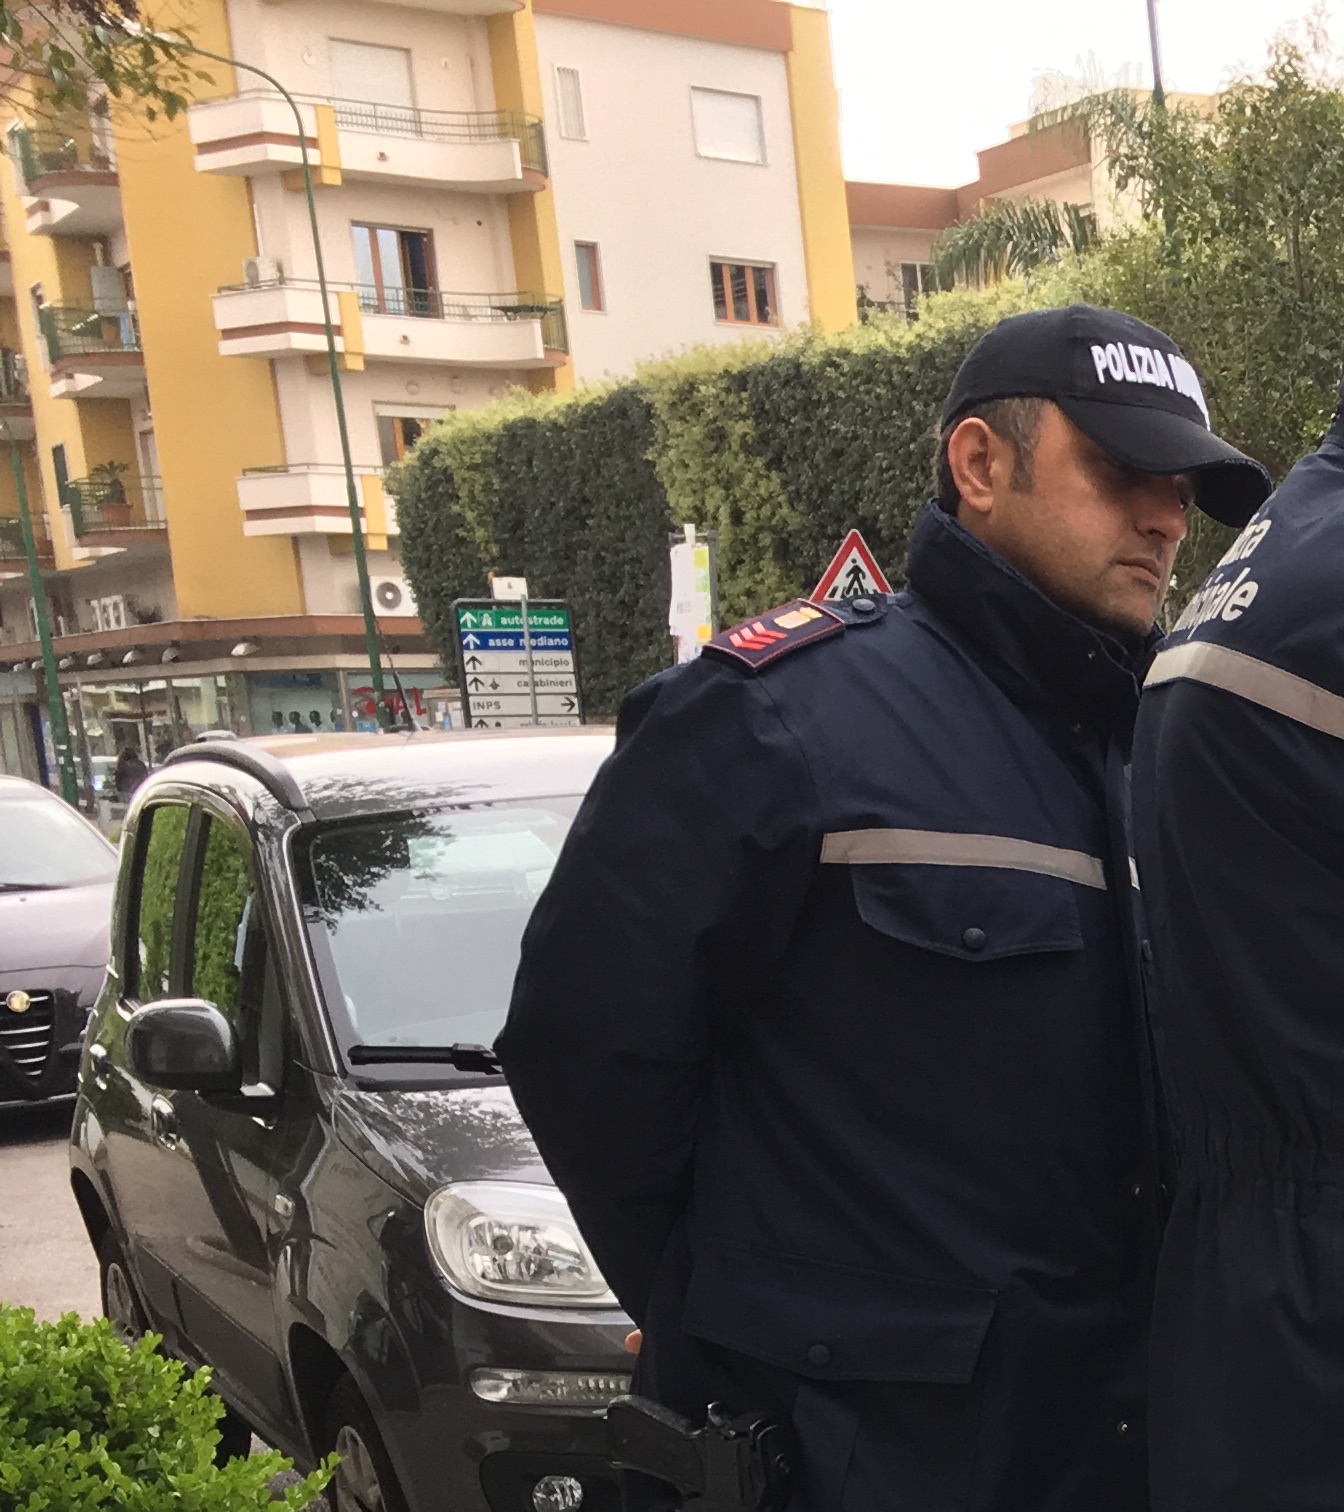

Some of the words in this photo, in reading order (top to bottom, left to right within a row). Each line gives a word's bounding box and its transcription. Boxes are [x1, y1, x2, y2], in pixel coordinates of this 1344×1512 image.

[1090, 341, 1175, 390] POLIZIA
[488, 638, 514, 647] asse
[516, 679, 573, 688] caabinieri
[472, 700, 501, 710] INPS
